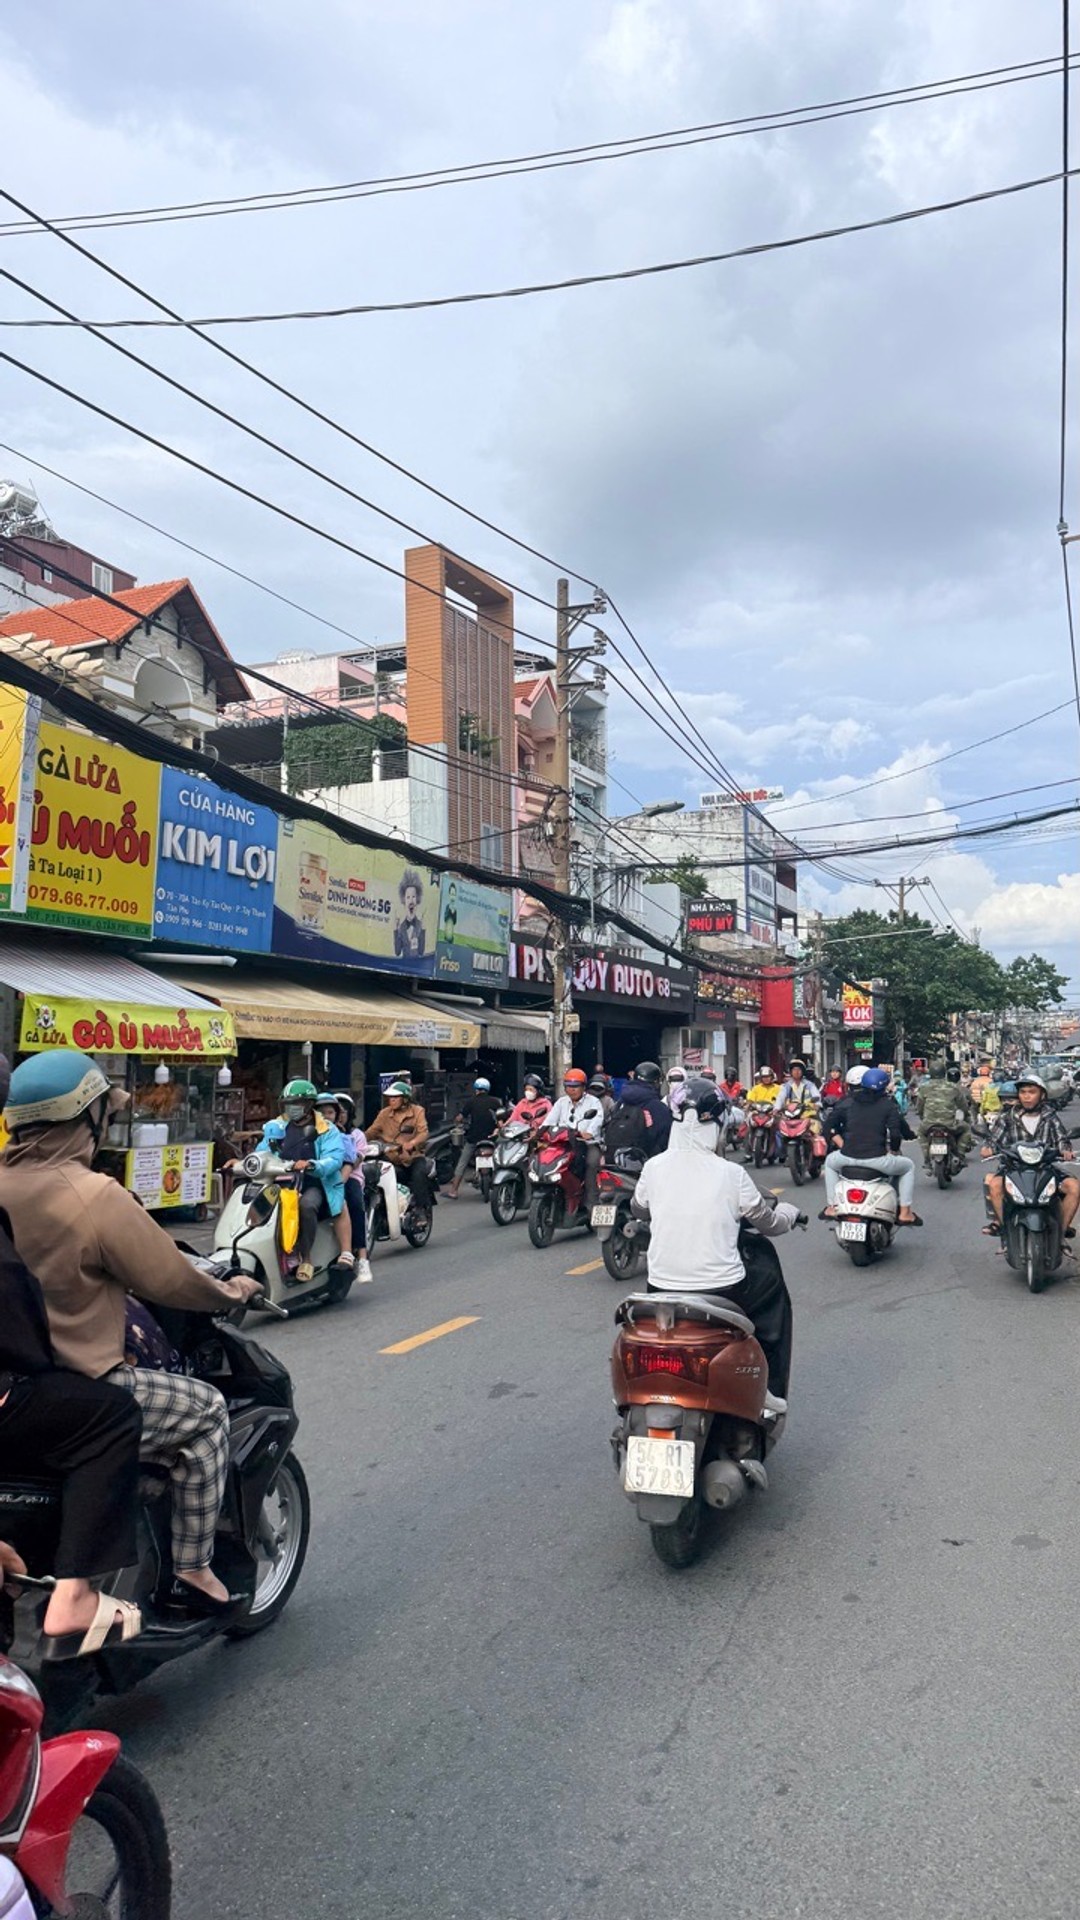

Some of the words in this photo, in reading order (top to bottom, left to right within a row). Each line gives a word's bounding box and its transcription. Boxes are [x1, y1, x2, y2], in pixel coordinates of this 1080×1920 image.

[37, 745, 71, 781] GÀ
[74, 754, 121, 794] LỬA
[179, 786, 212, 813] CỬA
[215, 800, 255, 826] HÀNG
[57, 800, 151, 867] MUỐI
[162, 821, 222, 870] KIM
[227, 839, 275, 889] LỢI
[38, 858, 55, 875] Ta
[58, 862, 85, 884] Loại
[28, 884, 138, 915] 079.66.77.009
[327, 889, 348, 905] DINH
[377, 898, 391, 914] 5G
[691, 903, 707, 912] NHA
[689, 914, 712, 931] PHÚ
[613, 964, 653, 998] AUTO
[656, 976, 670, 997] 68
[844, 1006, 870, 1020] 10K
[26, 1028, 39, 1042] GÀ
[73, 1009, 115, 1050] GÀ
